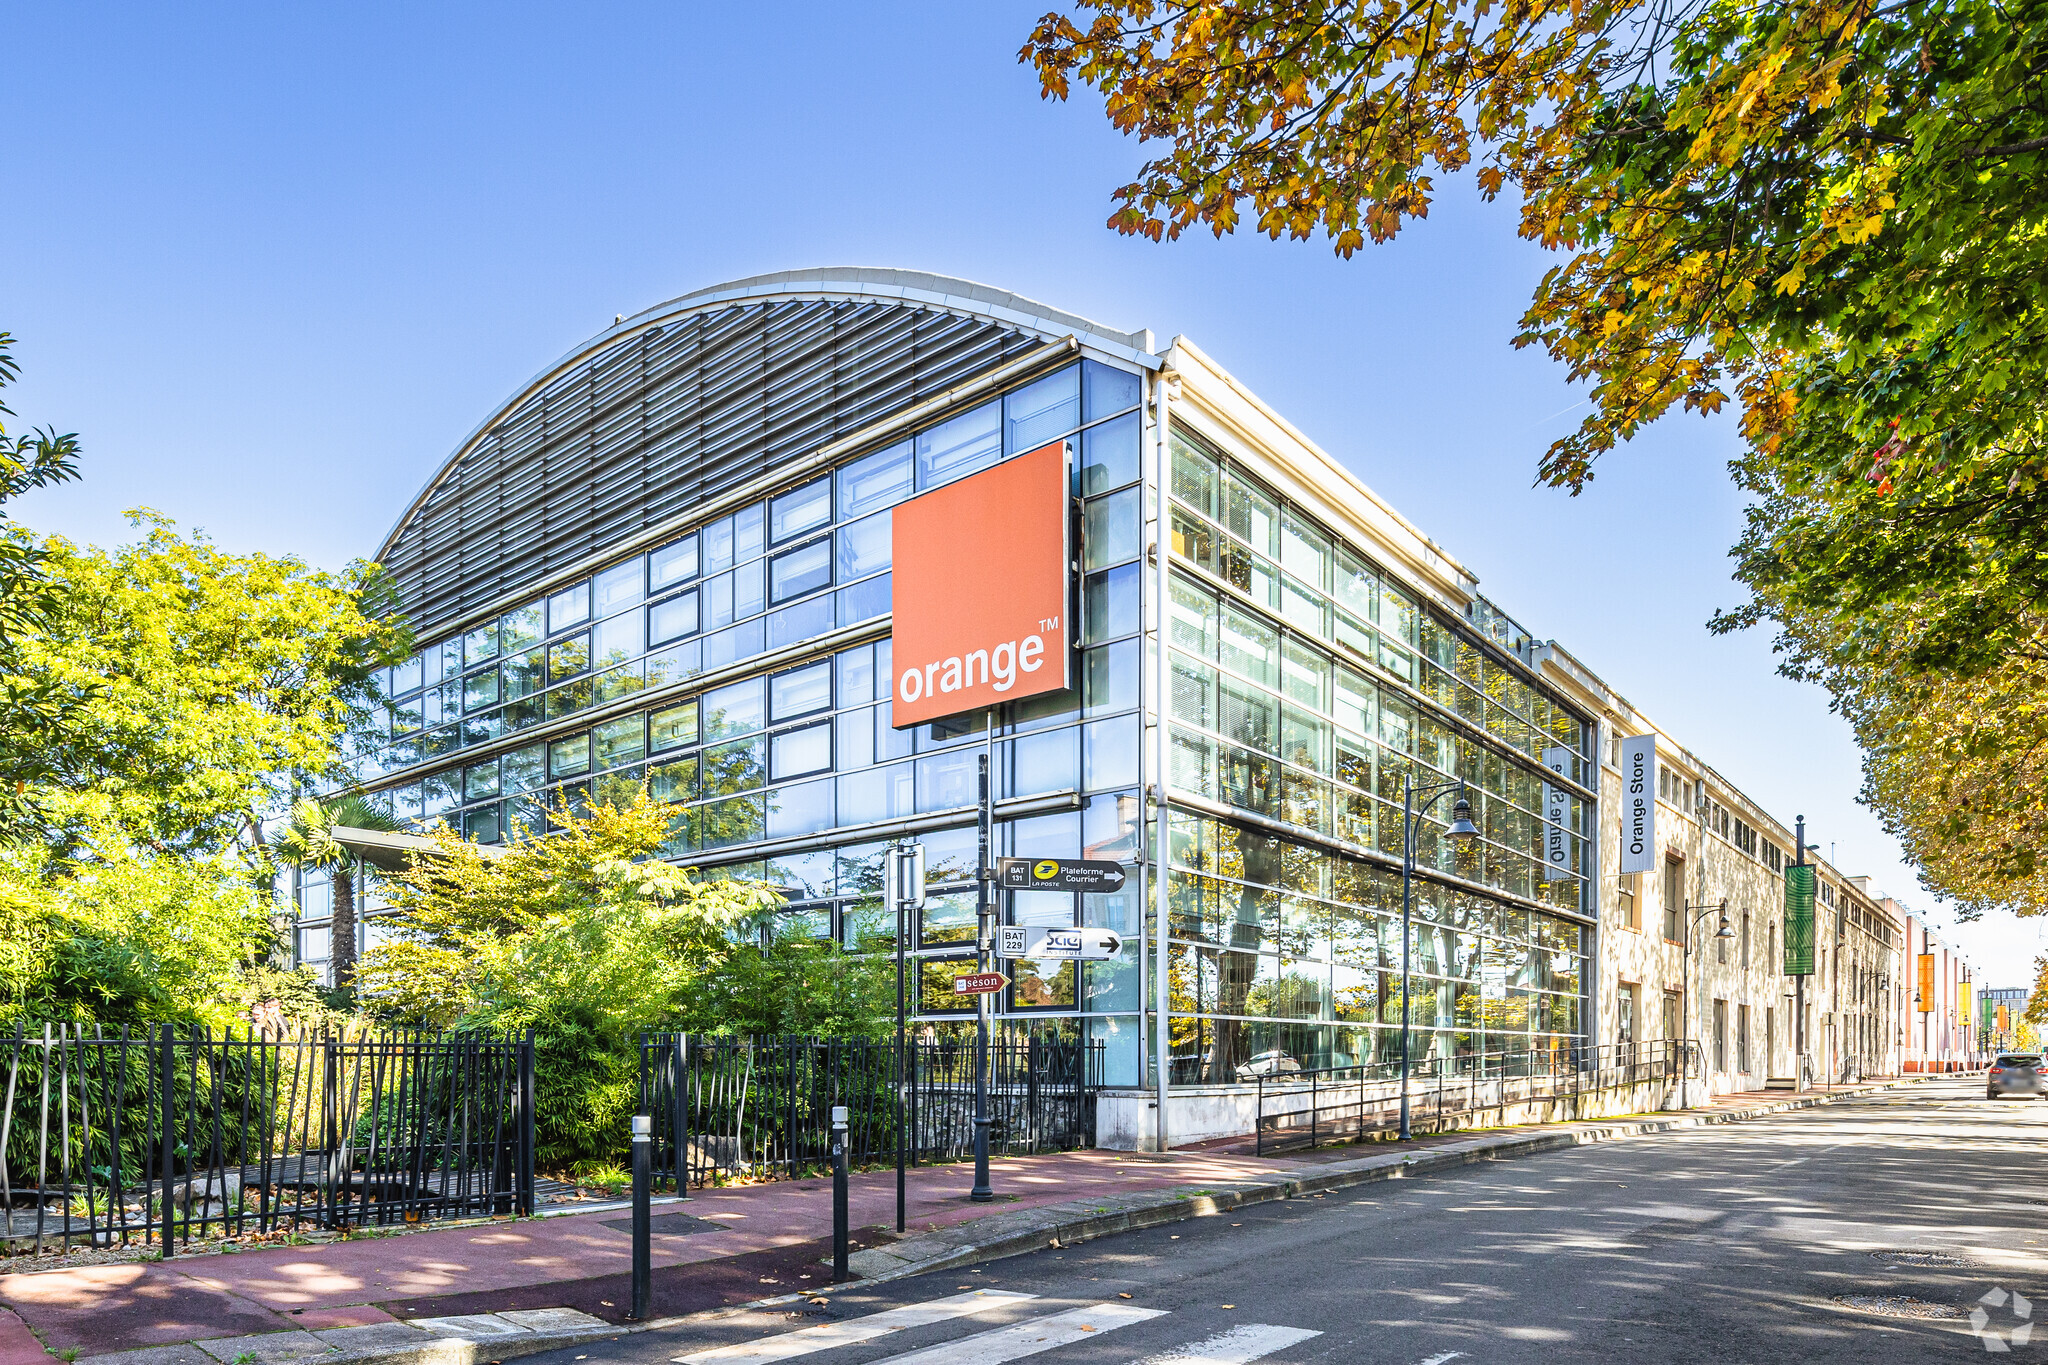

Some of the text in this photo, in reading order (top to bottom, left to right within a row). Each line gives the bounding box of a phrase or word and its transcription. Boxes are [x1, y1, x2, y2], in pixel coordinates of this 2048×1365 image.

[900, 616, 1059, 703] orange TM
[1630, 752, 1646, 854] Orange Store
[1060, 867, 1104, 876] Plateforme
[1005, 932, 1024, 940] BAT
[1006, 941, 1022, 949] 229
[966, 976, 998, 987] sèson
